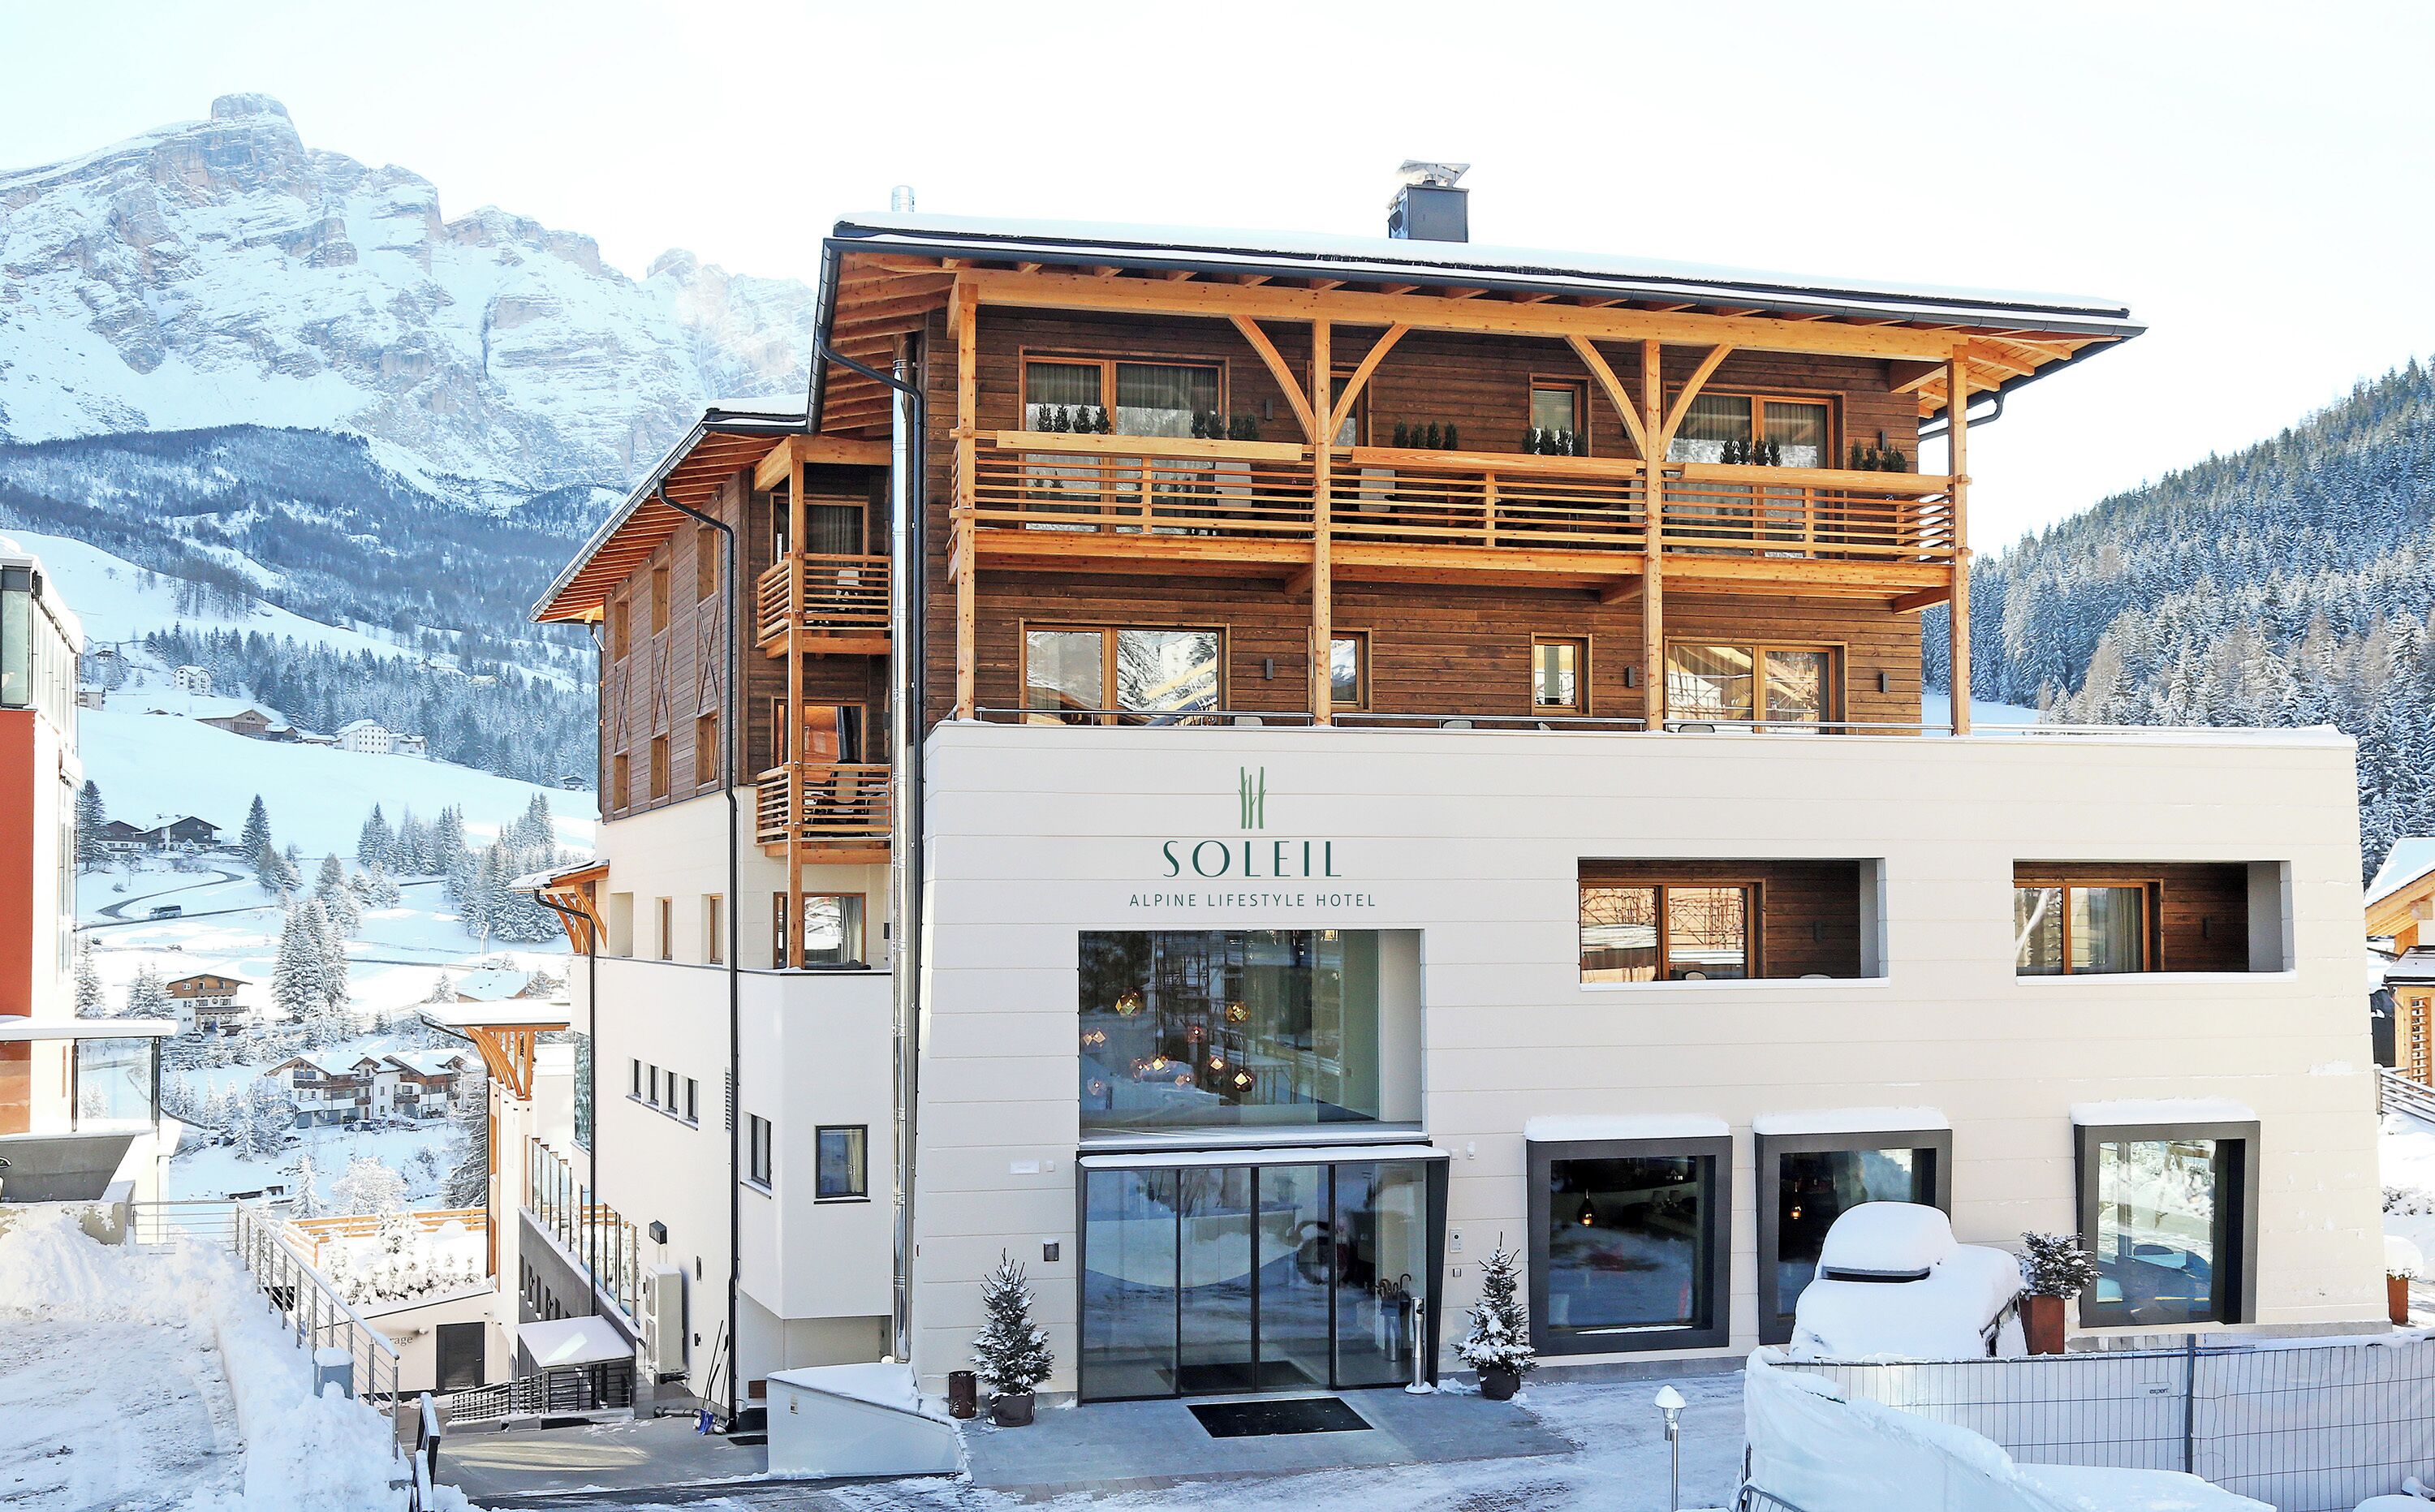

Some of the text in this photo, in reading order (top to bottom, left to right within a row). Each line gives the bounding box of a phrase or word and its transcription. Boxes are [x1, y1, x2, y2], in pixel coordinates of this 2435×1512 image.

[1162, 839, 1342, 878] SOLEIL
[1129, 894, 1376, 907] ALPINE LIFESTYLE HOTEL
